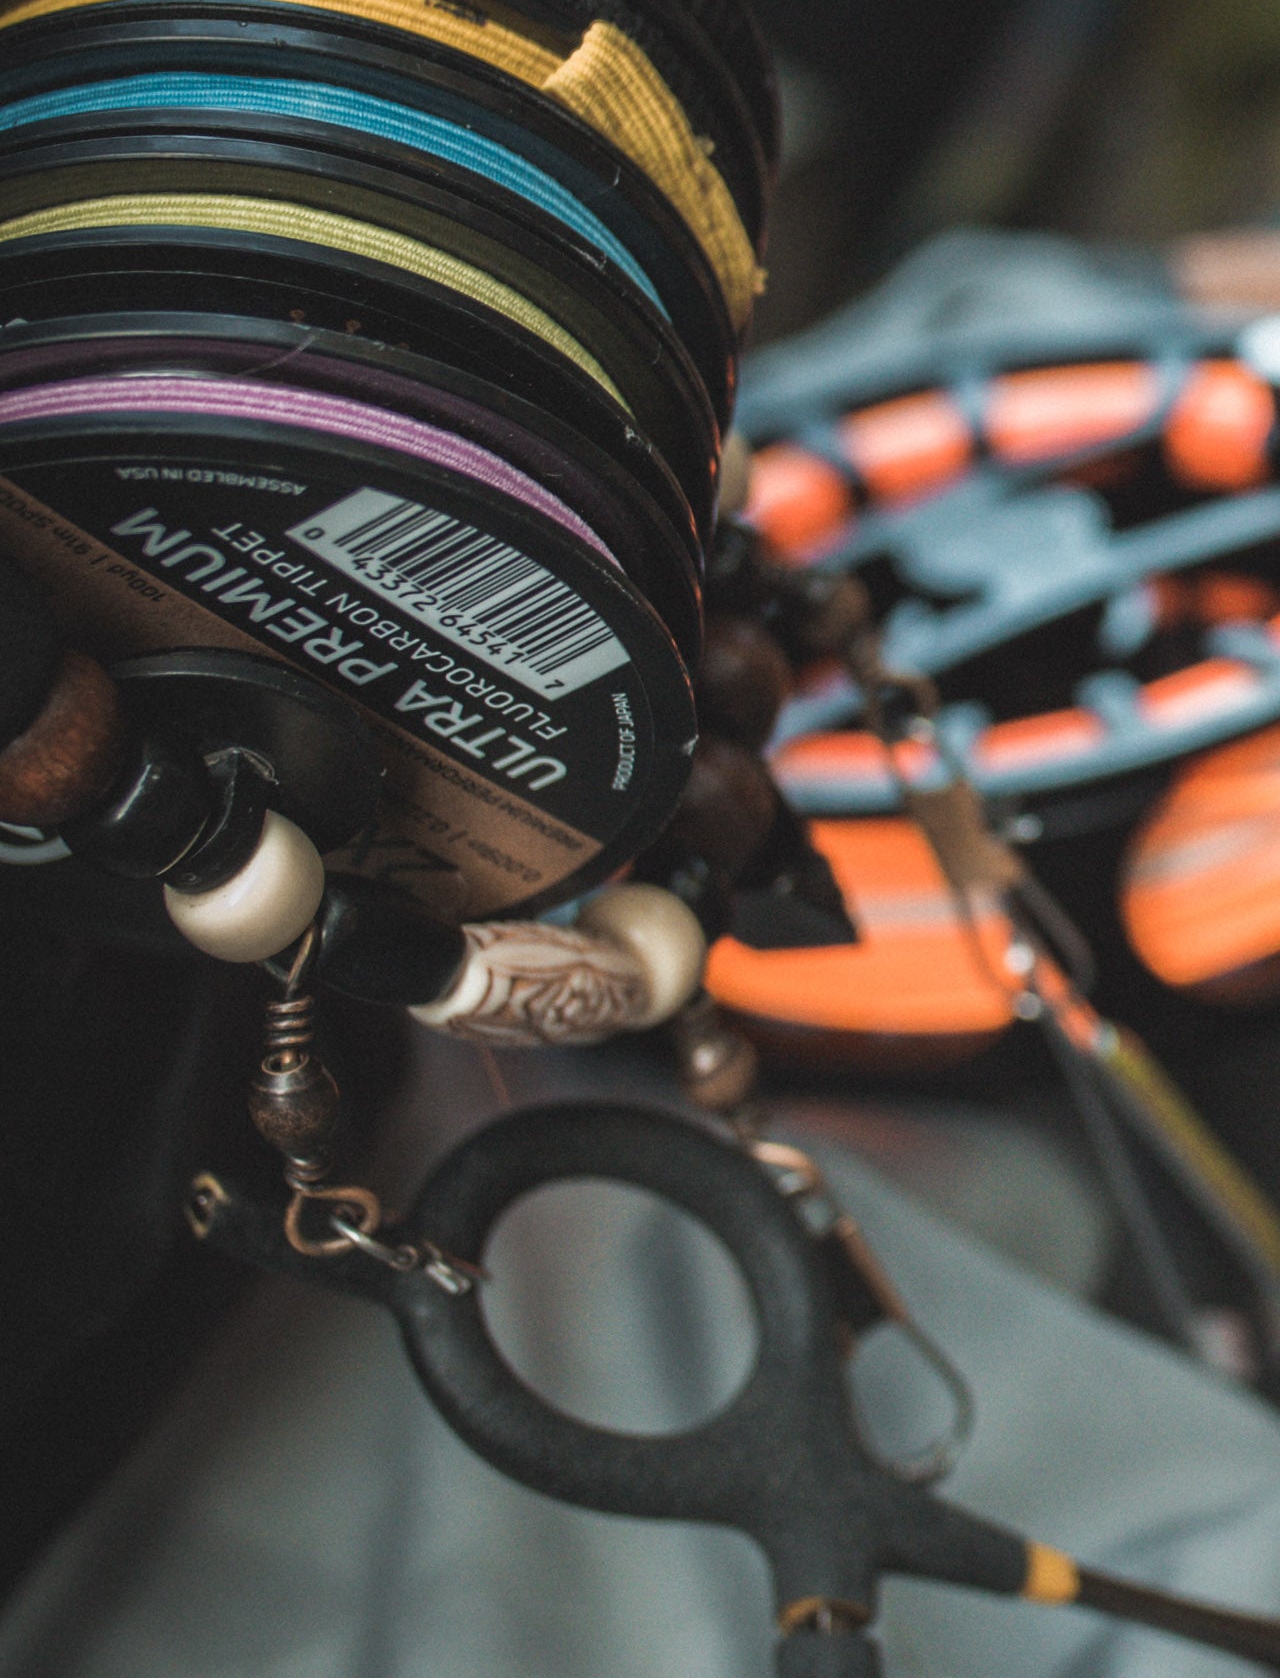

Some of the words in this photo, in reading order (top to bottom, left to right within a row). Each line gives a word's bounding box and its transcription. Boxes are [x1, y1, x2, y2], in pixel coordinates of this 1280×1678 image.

[116, 466, 158, 480] USA
[161, 467, 184, 480] IN
[185, 469, 308, 496] ASSEMBLED
[210, 523, 328, 596] TIPPET
[110, 507, 399, 686] PREMIUM
[303, 527, 325, 540] 0
[351, 556, 438, 612] 43372
[439, 614, 526, 665] 64541
[544, 679, 565, 690] 7
[325, 592, 568, 740] FLUOROCARBON
[611, 692, 635, 727] JAPAN
[394, 679, 567, 791] ULTRA
[619, 727, 636, 742] OF
[612, 743, 636, 791] PRODUCT
